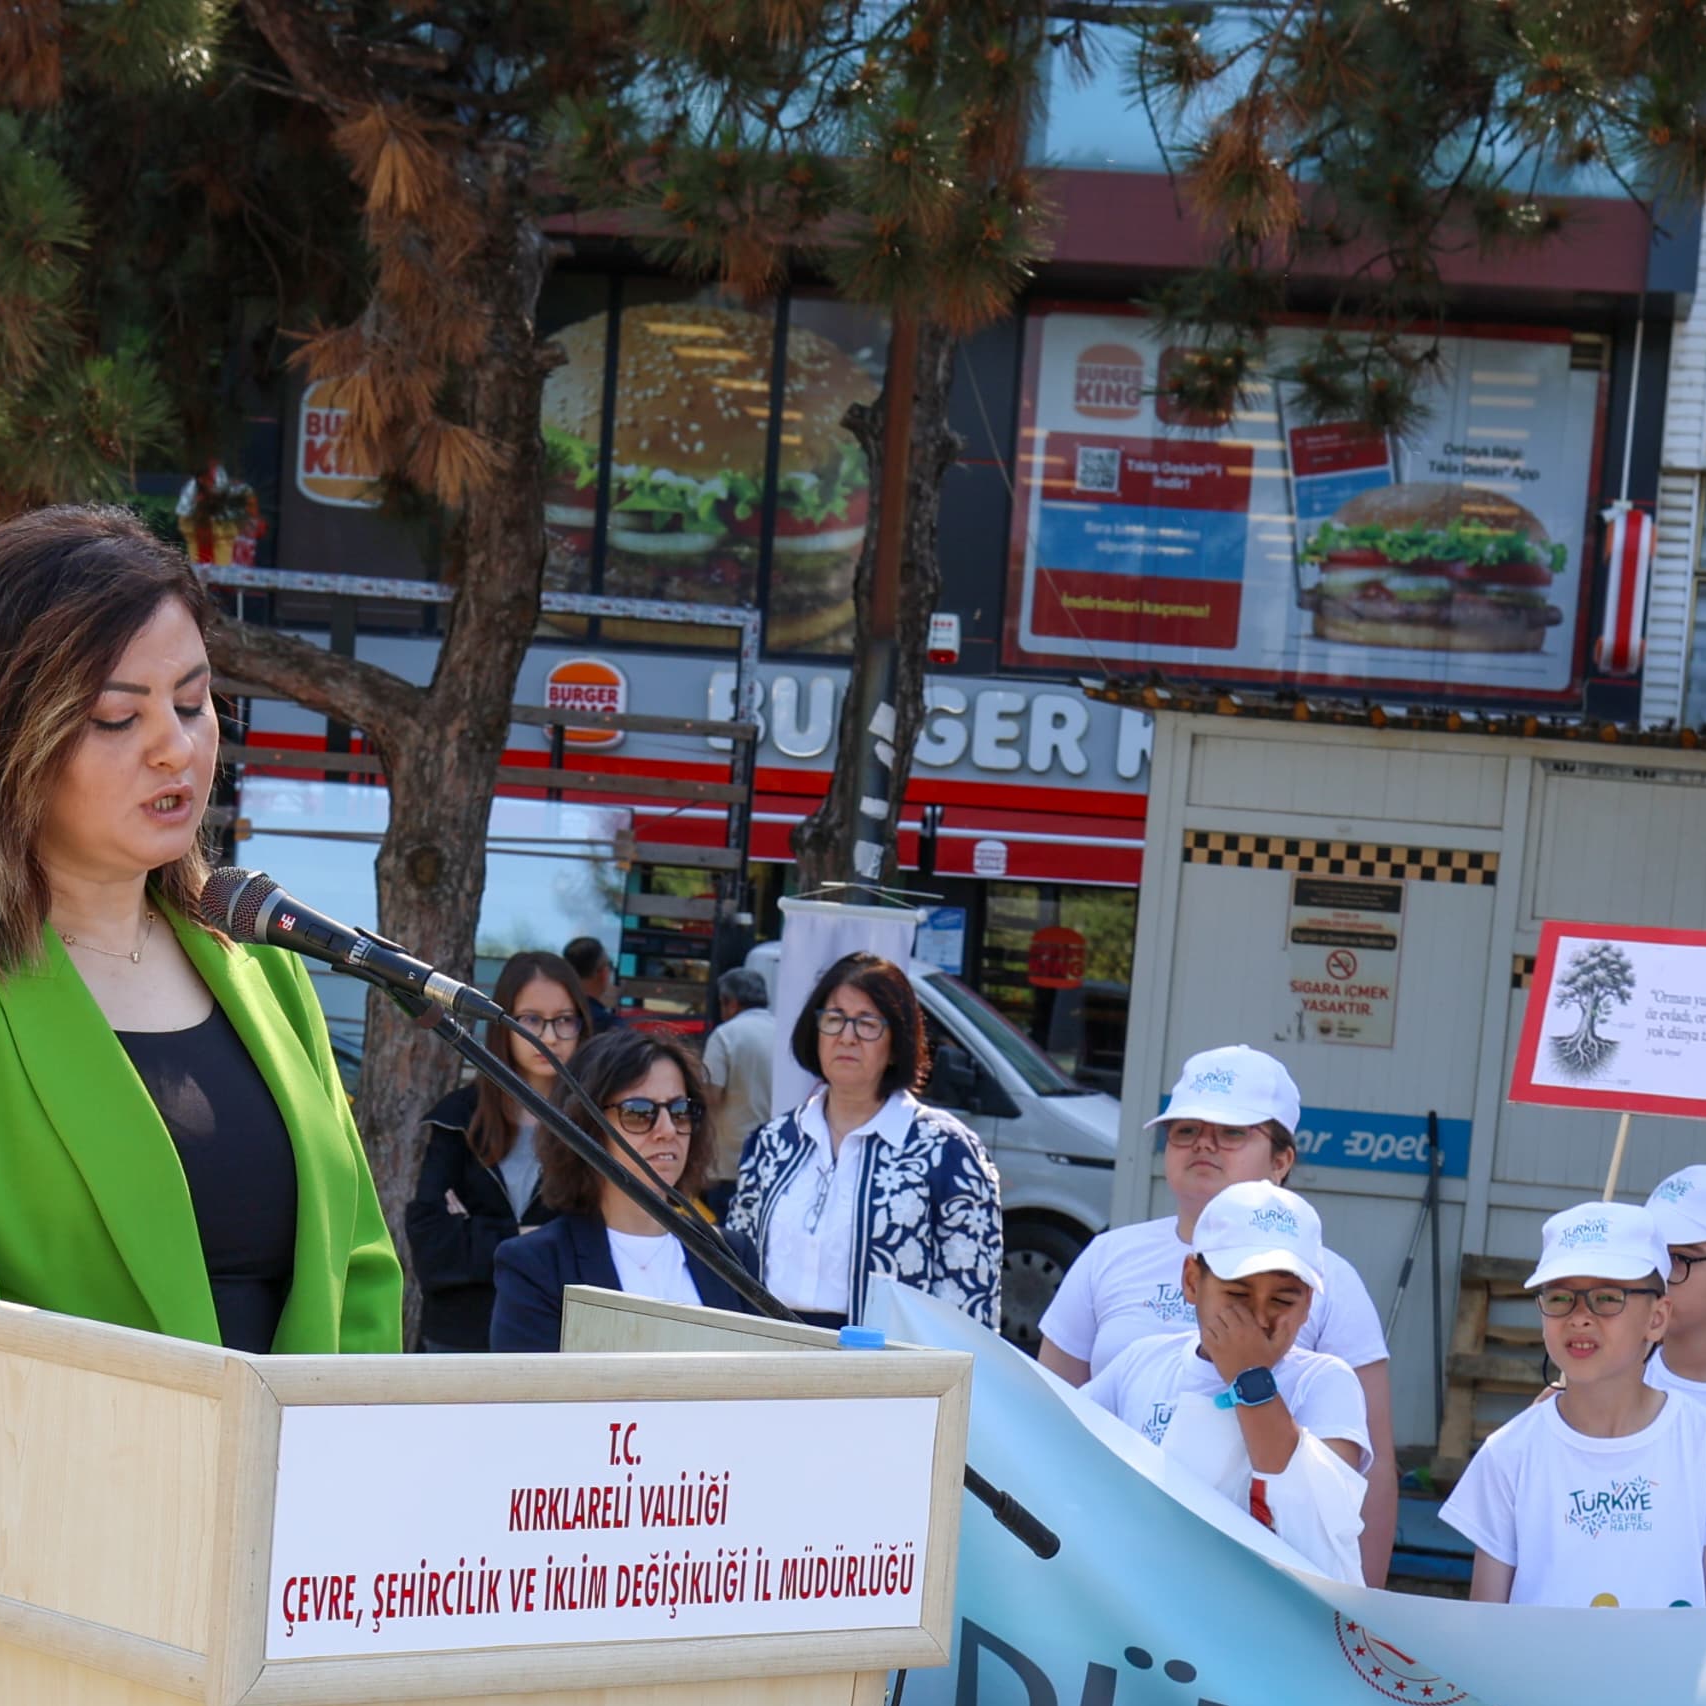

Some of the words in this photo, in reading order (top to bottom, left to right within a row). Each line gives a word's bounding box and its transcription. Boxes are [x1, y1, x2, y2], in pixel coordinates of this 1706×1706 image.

[549, 686, 618, 704] BURGER
[707, 670, 1090, 777] BUGER
[609, 1423, 642, 1466] T.C.
[508, 1472, 633, 1532] KIRKLARELİ
[638, 1470, 730, 1528] VALİLİĞİ
[282, 1574, 363, 1637] ÇEVRE,
[372, 1558, 502, 1633] ŞEHİRCİLİK
[509, 1567, 536, 1613] VE
[543, 1553, 607, 1611] İKLİM
[615, 1546, 748, 1619] DEĞİŞİKLİĞİ
[754, 1546, 772, 1601] İL
[779, 1541, 916, 1600] MÜDÜRLÜĞÜ
